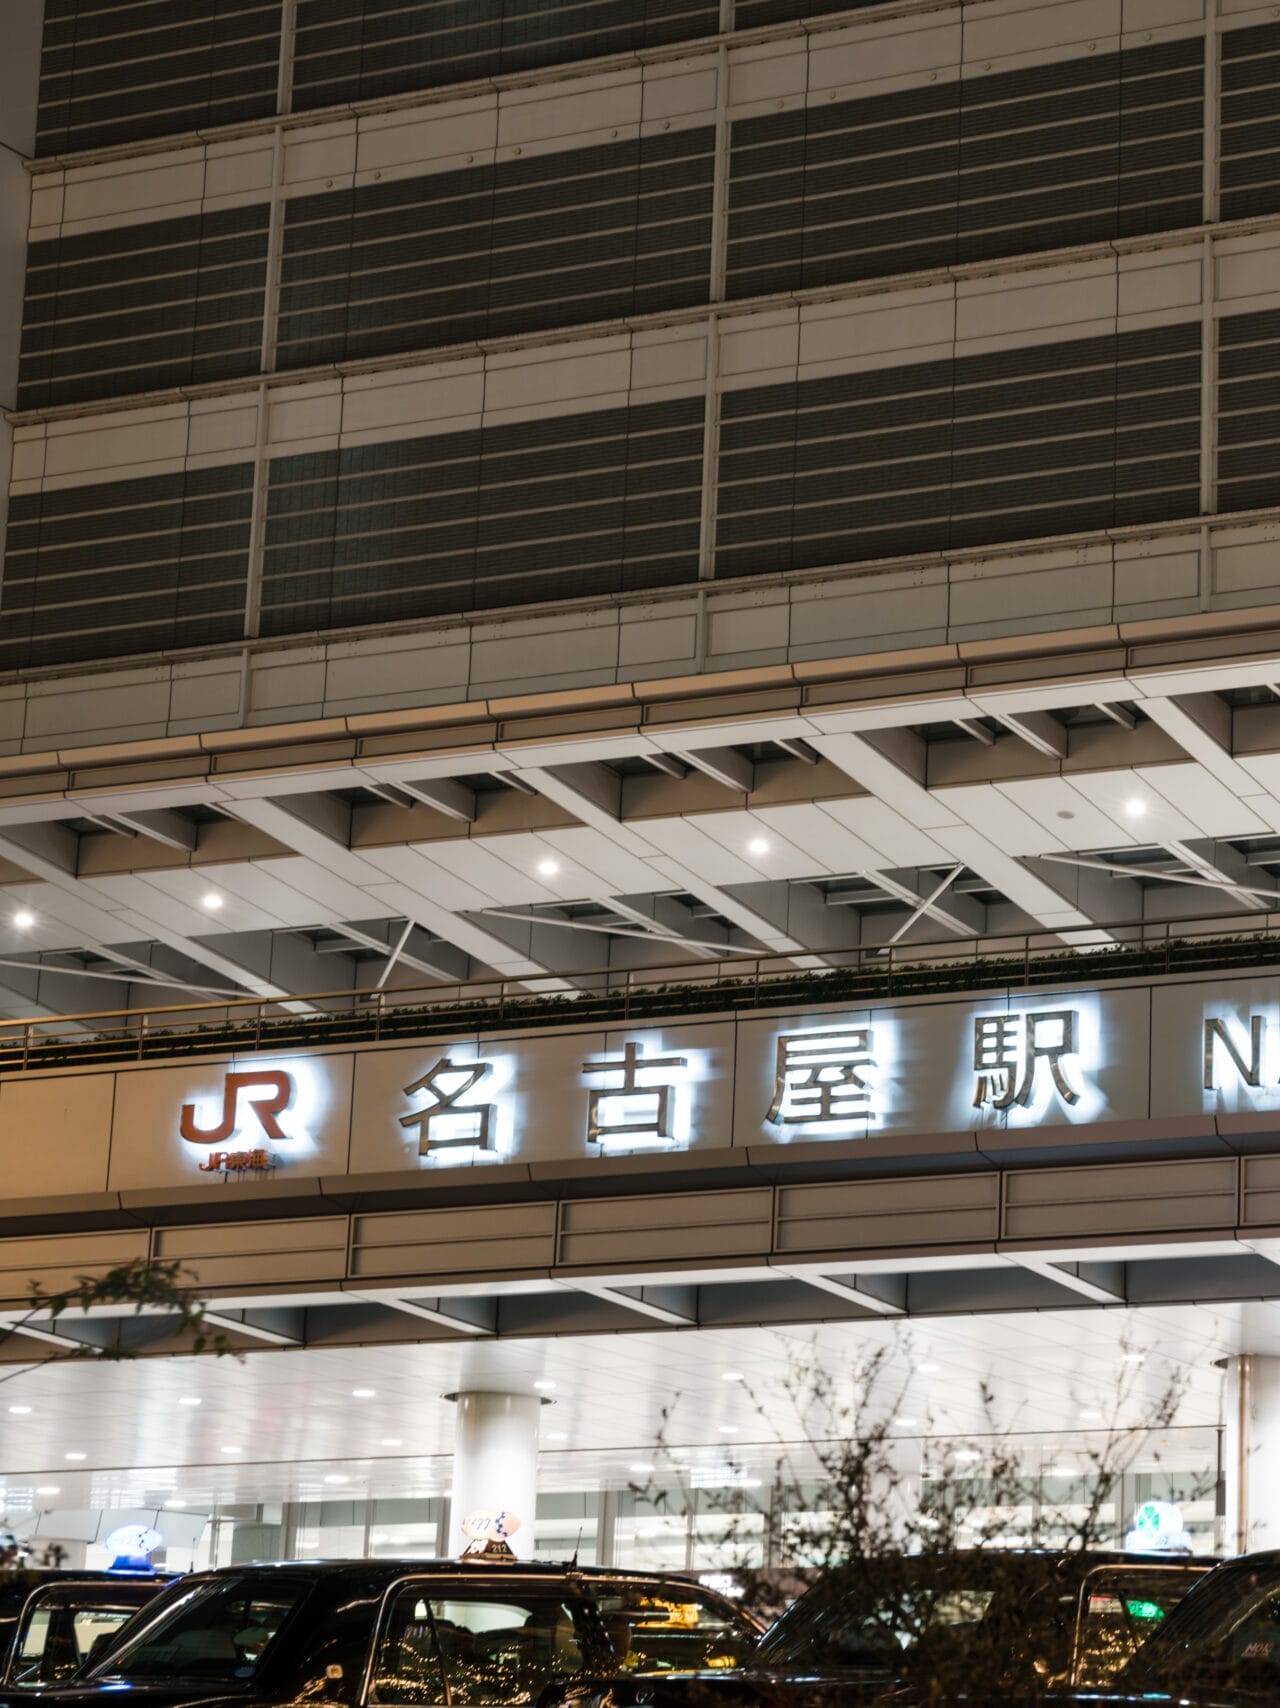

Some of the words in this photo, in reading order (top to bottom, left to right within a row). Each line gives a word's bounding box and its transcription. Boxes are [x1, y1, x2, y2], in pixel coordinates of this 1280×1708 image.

[180, 1070, 292, 1144] JR
[399, 1011, 1080, 1158] 名古屋駅
